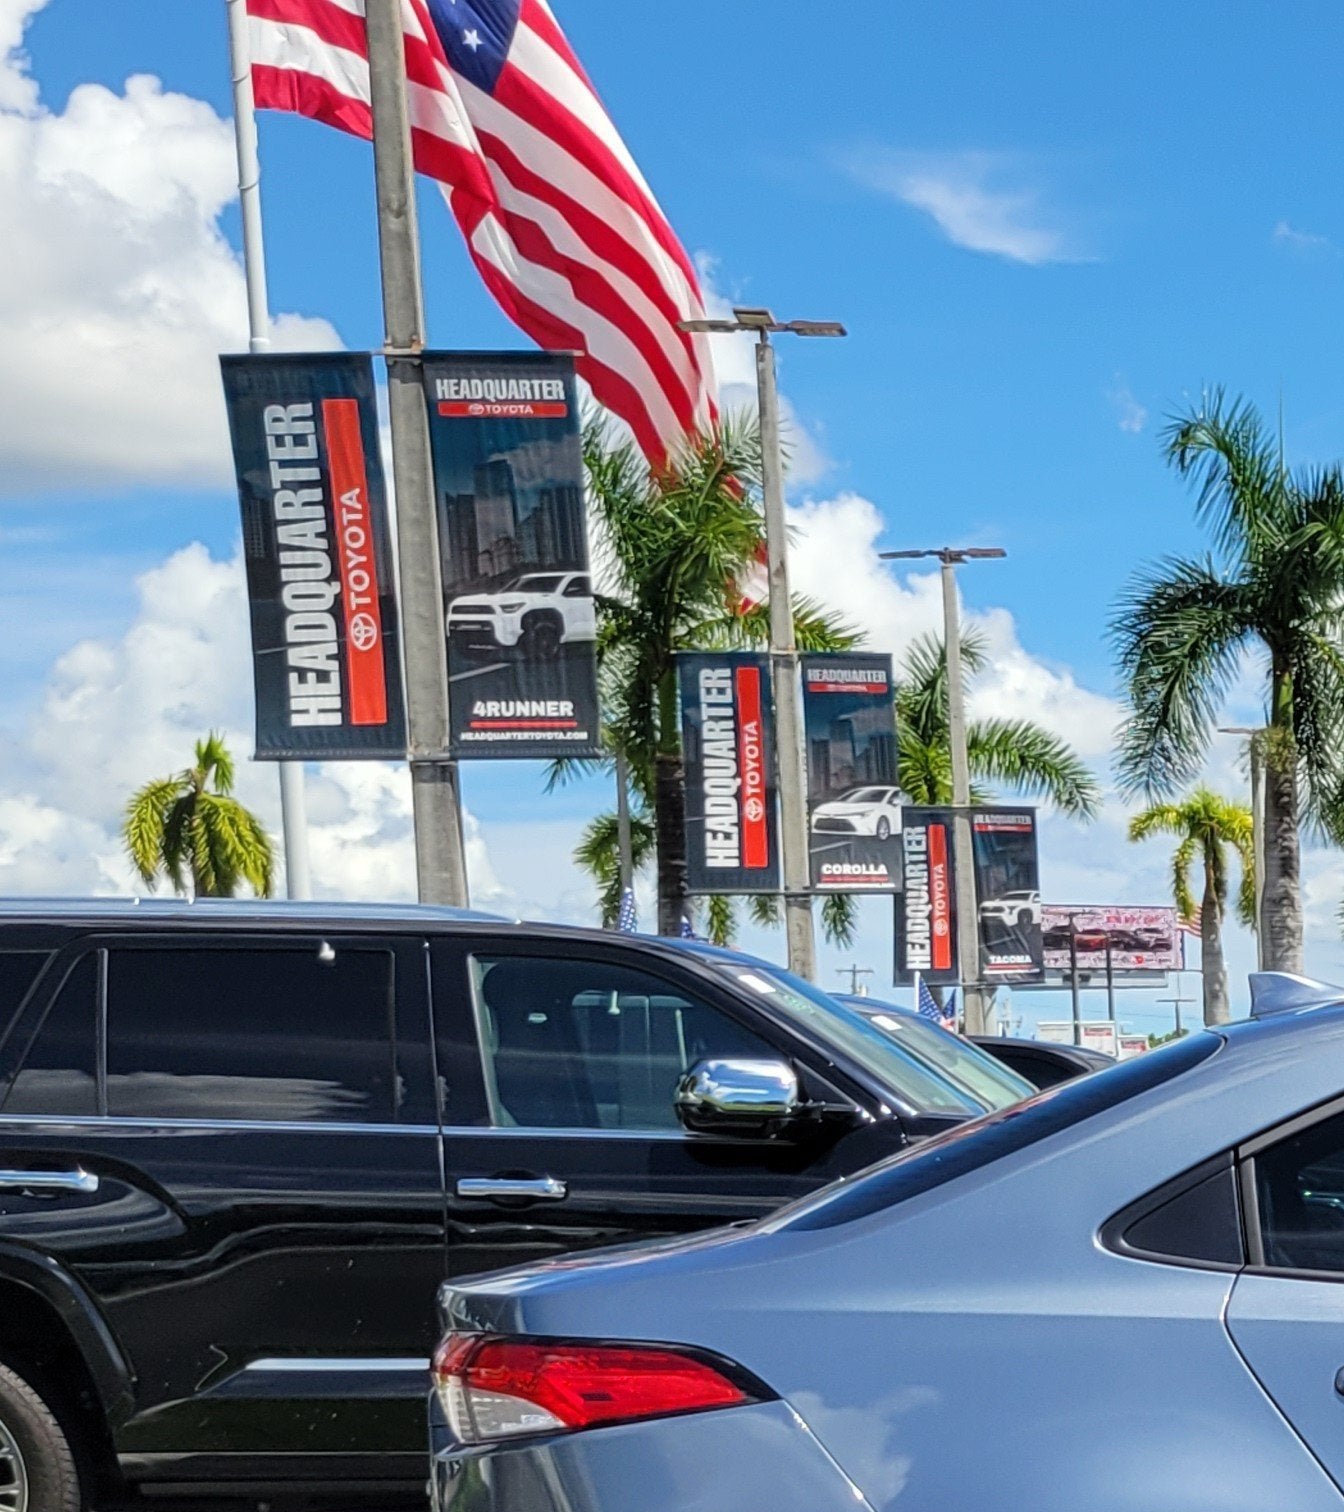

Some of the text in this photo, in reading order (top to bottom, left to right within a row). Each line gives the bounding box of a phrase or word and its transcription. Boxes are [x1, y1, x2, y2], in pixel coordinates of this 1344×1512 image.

[436, 378, 565, 400] HEADQUARTER
[485, 404, 533, 414] TOYOTA
[264, 402, 342, 727] HEADQUARTER
[340, 487, 371, 610] TOYOTA
[807, 668, 887, 684] HEADQUARTER
[473, 701, 574, 718] 4RUNNER
[699, 667, 741, 868] HEADQUARTER
[742, 721, 763, 798] TOYOTA
[821, 863, 888, 875] COROLLA
[903, 826, 928, 970] HEADQUARTER
[932, 864, 946, 919] TOYOTA
[988, 955, 1032, 964] TACOMA
